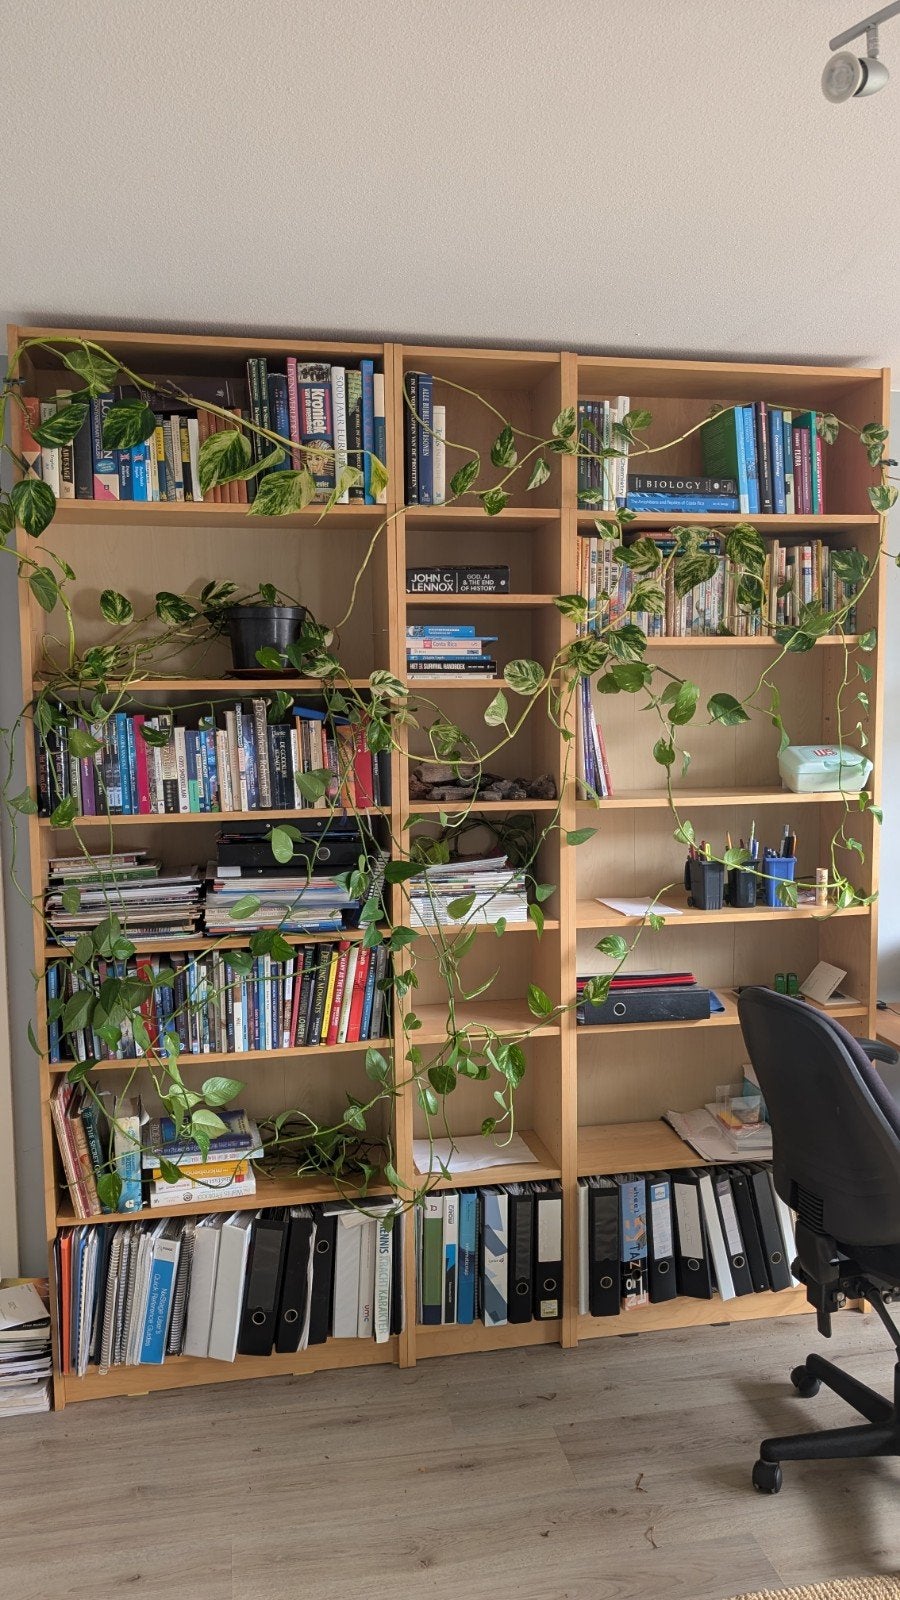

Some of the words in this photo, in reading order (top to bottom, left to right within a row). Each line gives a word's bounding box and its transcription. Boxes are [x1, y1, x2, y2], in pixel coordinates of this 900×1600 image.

[289, 396, 297, 437] VERLEDEN
[305, 408, 313, 434] mensheid
[312, 389, 327, 434] Kroniek
[336, 402, 344, 425] JAAR
[337, 430, 346, 469] EUROPA
[618, 459, 627, 496] Chemistry
[646, 480, 701, 490] BIOLOGY
[411, 573, 440, 583] JOHN
[444, 573, 454, 583] C.
[412, 583, 454, 592] LENNOX
[256, 705, 263, 717] De
[256, 718, 266, 754] Zondvloed
[318, 951, 330, 981] DEFING
[314, 982, 324, 1014] MOMENTS
[297, 1016, 307, 1038] LOWERY
[86, 1125, 94, 1139] THE
[89, 1140, 98, 1163] SECRET
[152, 1273, 161, 1291] Quick
[379, 1255, 388, 1288] KRACHT
[148, 1293, 159, 1323] Reference
[363, 1304, 371, 1322] umc
[379, 1289, 389, 1334] KARAKTER
[145, 1325, 154, 1347] Guides
[155, 1315, 165, 1334] User's
